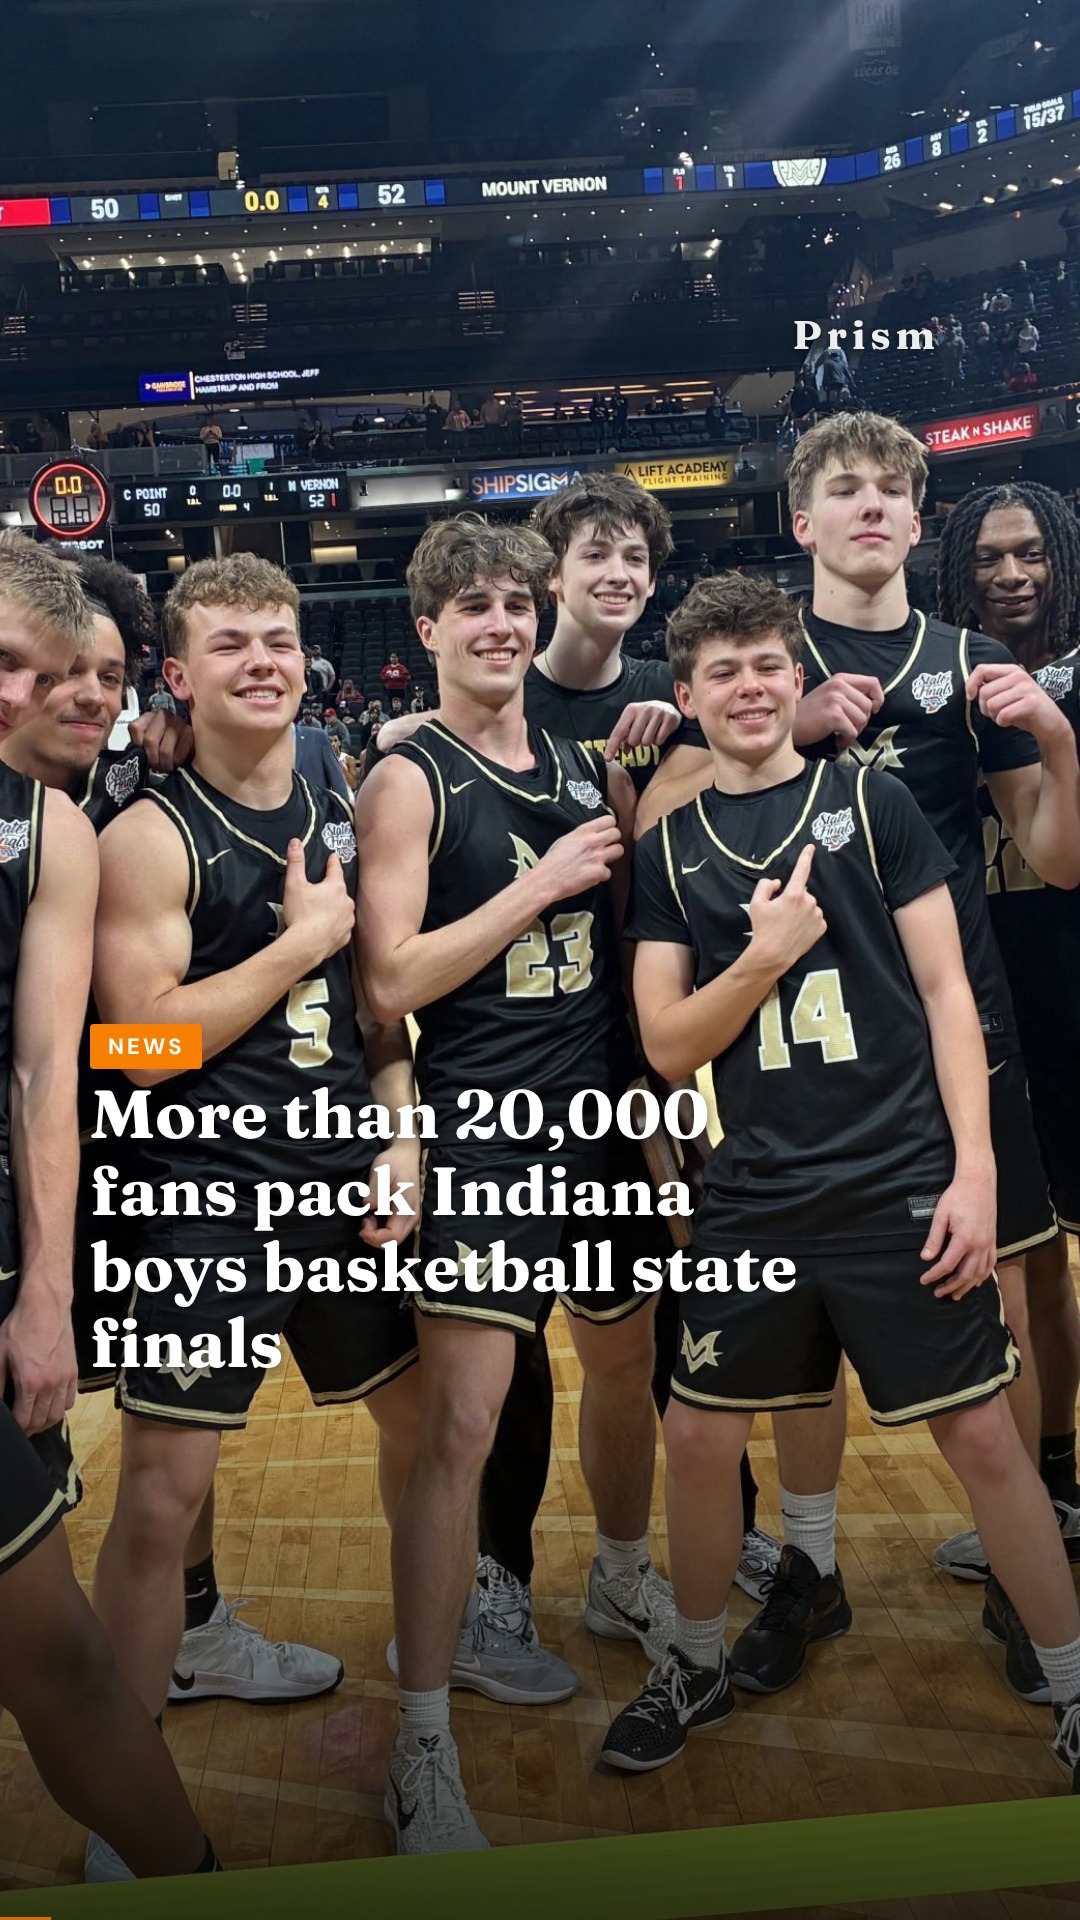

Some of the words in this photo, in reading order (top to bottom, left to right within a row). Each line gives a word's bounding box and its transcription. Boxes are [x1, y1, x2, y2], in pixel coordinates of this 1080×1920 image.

[1023, 105, 1065, 130] 15/37
[977, 128, 988, 144] 2
[932, 141, 942, 156] 8
[884, 153, 901, 171] 26
[481, 180, 540, 198] MOUNT
[543, 176, 608, 195] VERNON
[675, 176, 683, 190] 1
[725, 173, 733, 188] 1
[244, 190, 280, 212] 0.0
[318, 194, 329, 208] 4
[377, 184, 406, 205] 52
[91, 198, 119, 219] 50
[194, 373, 247, 384] CHESTERTON
[246, 371, 267, 382] HIGH
[301, 368, 320, 378] JEFF
[195, 383, 238, 394] HAMSTRUP
[238, 383, 255, 392] AND
[255, 381, 279, 391] FROM
[925, 425, 971, 446] STEAK
[982, 414, 1033, 437] SHAKE
[638, 464, 664, 478] LIFT
[666, 460, 728, 475] ACADEMY
[55, 476, 82, 495] 0.0
[300, 477, 339, 491] VERNON
[642, 474, 677, 486] FLIGHT
[679, 471, 729, 483] TRAINING
[123, 488, 132, 500] C
[136, 487, 168, 500] POINT
[189, 485, 197, 496] 0
[243, 502, 250, 512] 4
[308, 493, 326, 508] 52
[144, 503, 161, 517] 50
[912, 671, 952, 687] State
[1037, 665, 1073, 680] State
[912, 682, 953, 700] Finals
[812, 807, 851, 827] State
[322, 823, 351, 837] State
[812, 819, 855, 840] Finals
[506, 911, 594, 997] 23
[285, 978, 333, 1068] 5
[757, 967, 859, 1071] 14
